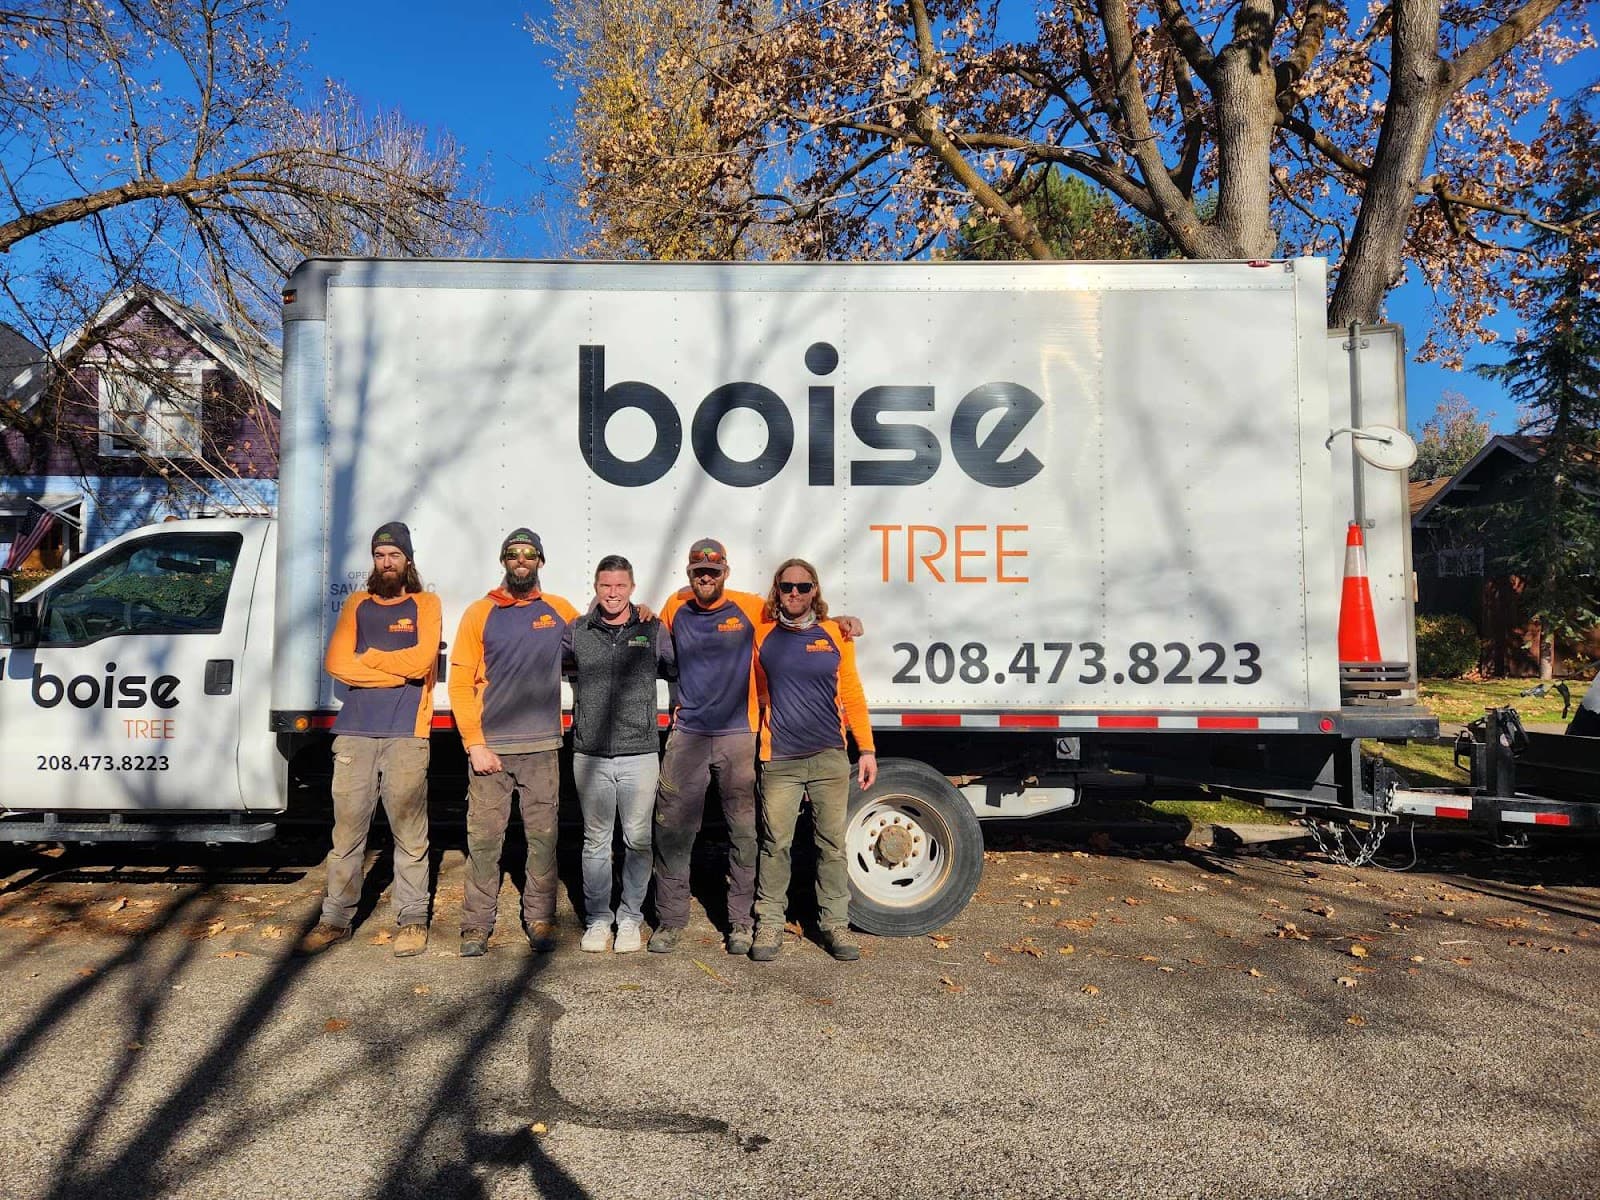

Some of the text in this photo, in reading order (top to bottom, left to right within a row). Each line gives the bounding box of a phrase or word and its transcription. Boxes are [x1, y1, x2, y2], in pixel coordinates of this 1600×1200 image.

[579, 342, 1044, 487] boise
[869, 525, 1029, 583] TREE
[330, 583, 368, 595] SAVA
[348, 571, 368, 580] OPE
[892, 641, 1261, 685] 208.473.8223
[32, 661, 181, 709] boise
[123, 719, 175, 739] TREE
[36, 755, 170, 771] 208.473.8223
